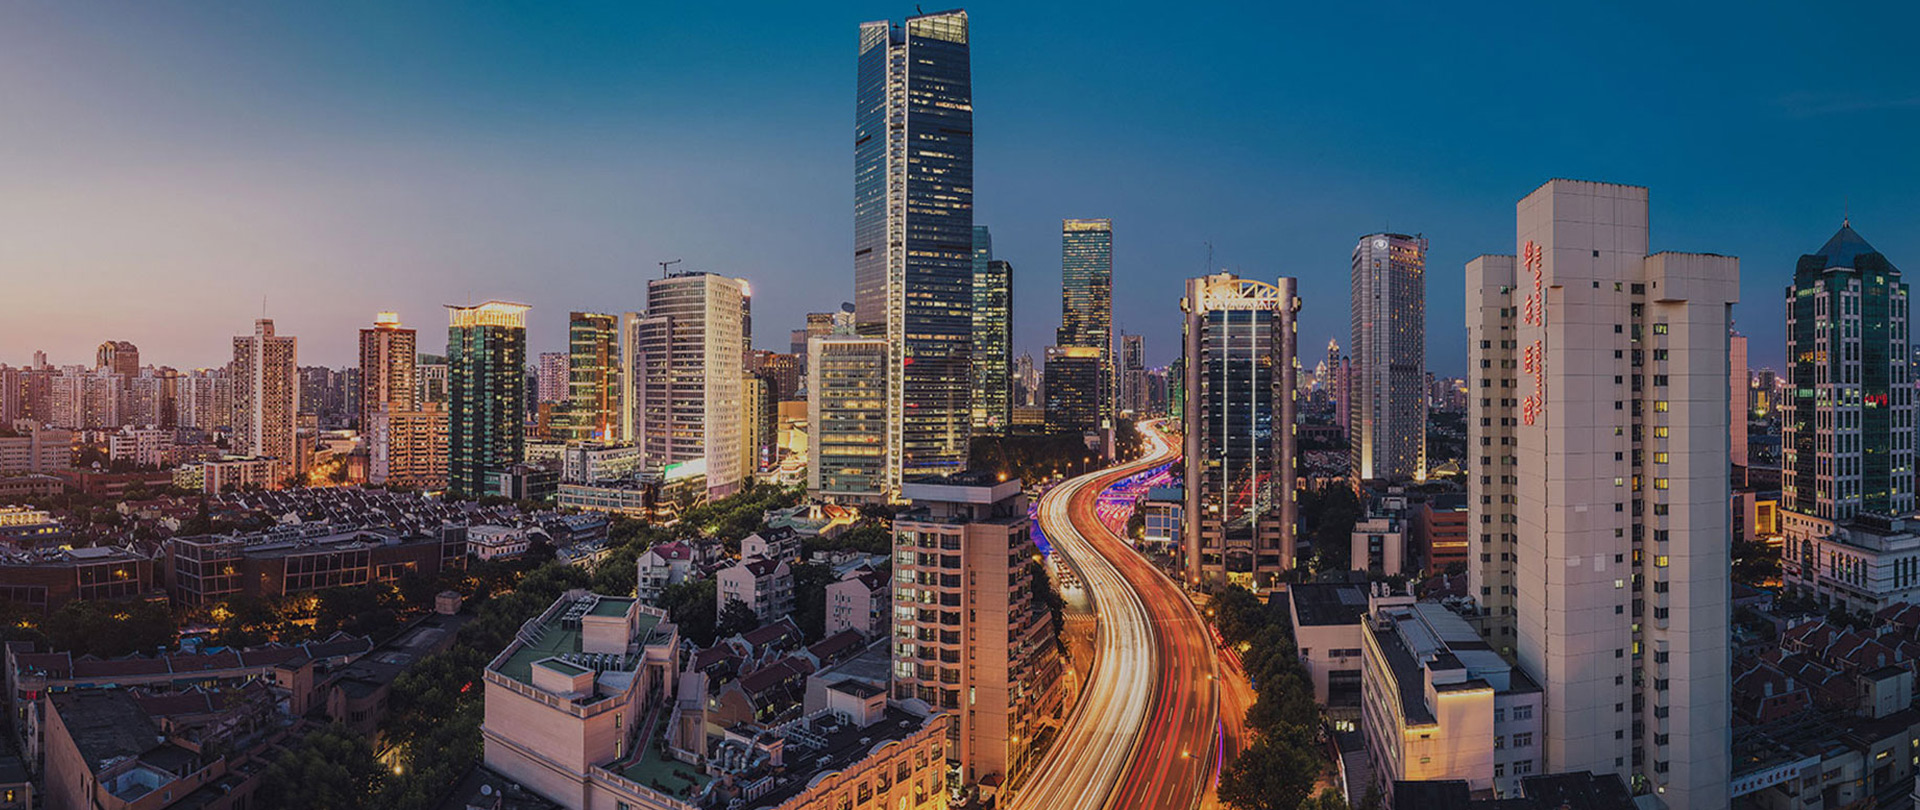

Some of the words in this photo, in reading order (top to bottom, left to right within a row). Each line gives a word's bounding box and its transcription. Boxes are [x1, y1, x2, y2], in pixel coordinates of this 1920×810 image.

[1534, 245, 1543, 328] HUADONG
[1523, 239, 1535, 426] 华东医院
[1534, 339, 1543, 417] HOSPITAL
